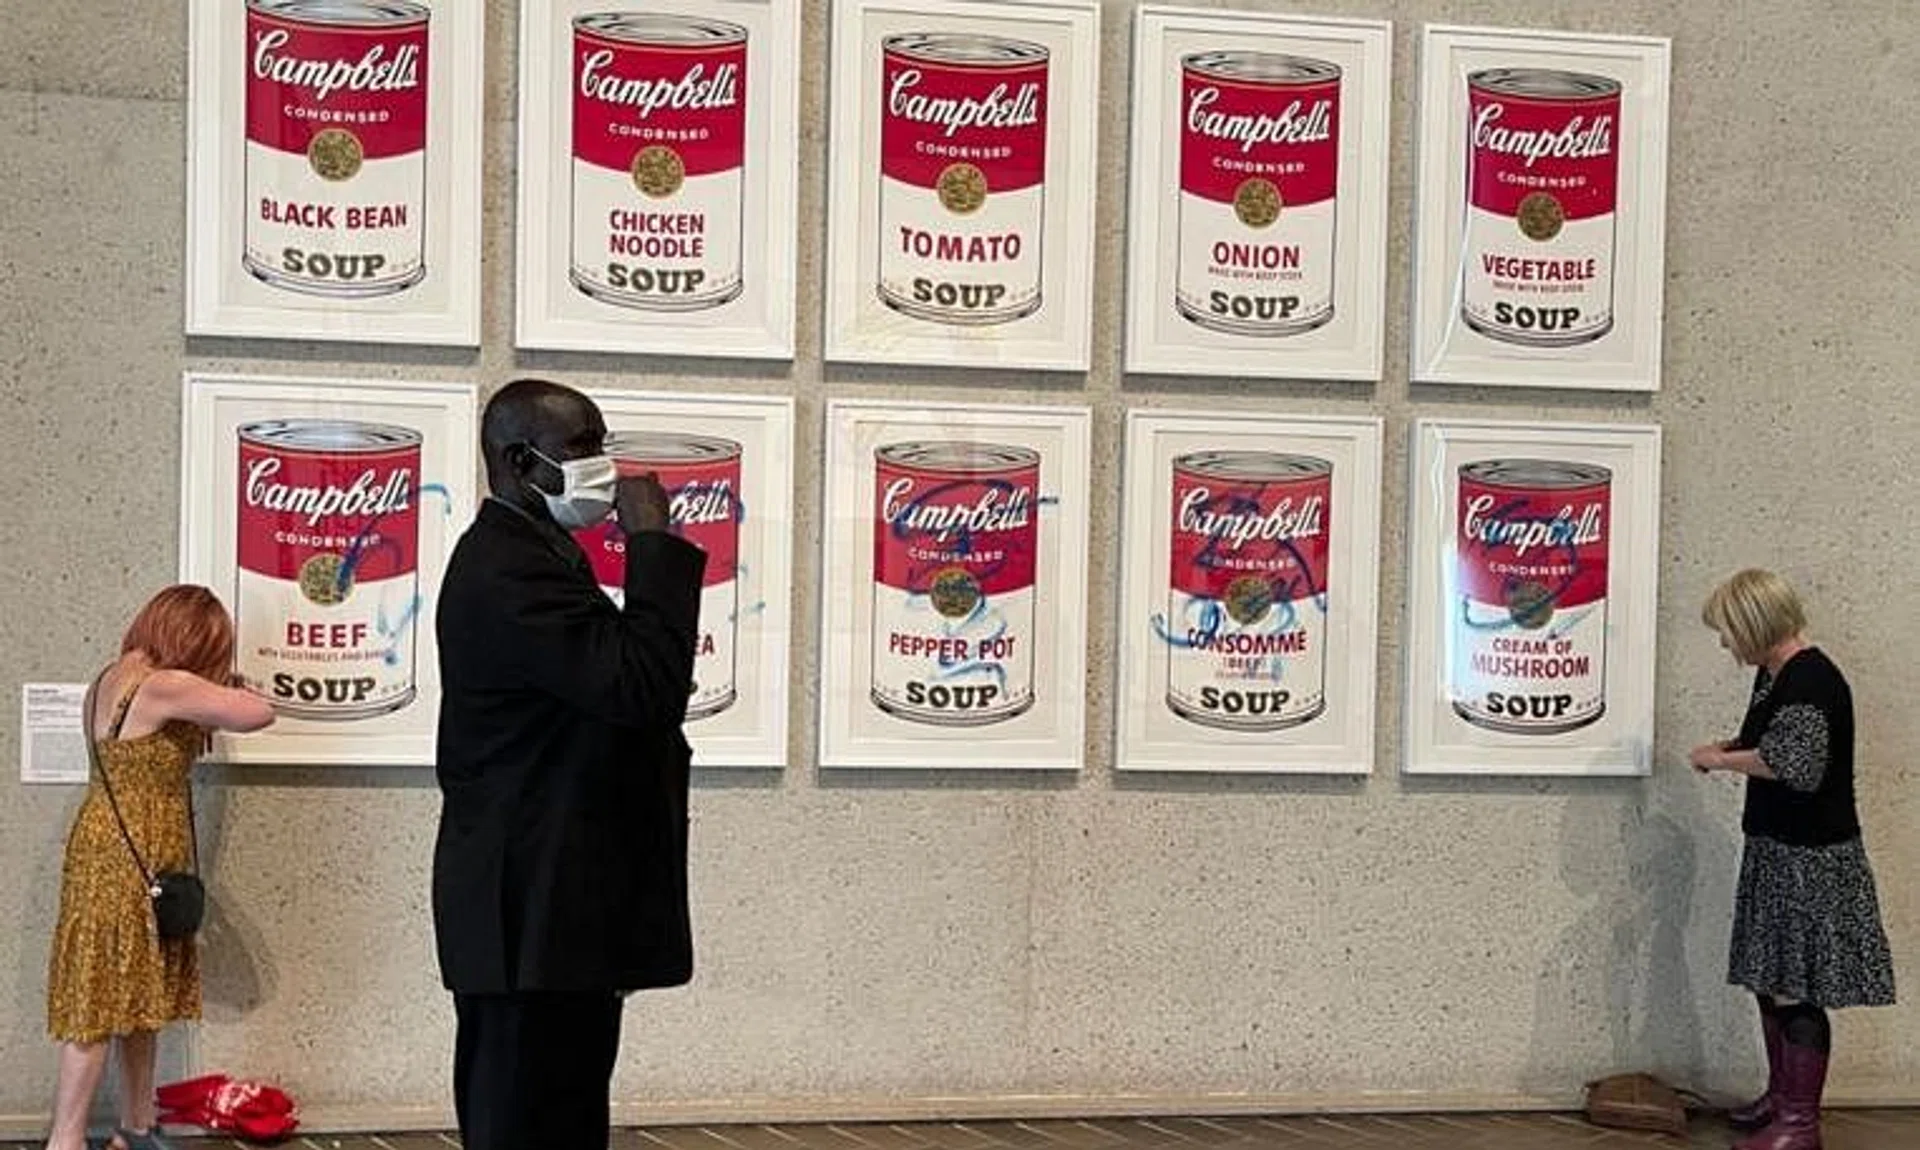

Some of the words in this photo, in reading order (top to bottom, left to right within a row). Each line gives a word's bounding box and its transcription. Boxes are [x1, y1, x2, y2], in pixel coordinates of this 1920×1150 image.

[254, 30, 420, 101] Campbell's
[581, 49, 738, 119] Campbell's
[283, 103, 390, 123] CONDENSED
[608, 122, 709, 141] CONDENSED
[915, 140, 1012, 159] CONDENSED
[1213, 156, 1305, 173] CONDENSED
[1498, 171, 1587, 188] CONDENSED
[260, 198, 336, 229] BLACK
[346, 204, 407, 229] BEAN
[609, 209, 704, 234] CHICKEN
[609, 234, 704, 258] NOODLE
[900, 226, 1021, 262] TOMATO
[1213, 241, 1300, 268] ONION
[282, 248, 386, 279] SOUP
[1482, 253, 1596, 281] VEGETABLE
[606, 262, 705, 294] SOUP
[912, 277, 1006, 308] SOUP
[1210, 290, 1299, 319] SOUP
[1494, 302, 1580, 330] SOUP
[1201, 554, 1297, 571] ONDENSED
[286, 622, 367, 648] BEEF
[889, 632, 967, 660] PEPPER
[979, 636, 1015, 660] POT
[1492, 638, 1550, 656] CREAM
[1555, 640, 1573, 656] OF
[1471, 654, 1590, 679] MUSHROOM
[272, 673, 376, 702] SOUP
[906, 681, 998, 709] SOUP
[1200, 687, 1290, 715] SOUP
[1486, 692, 1573, 718] SOUP
